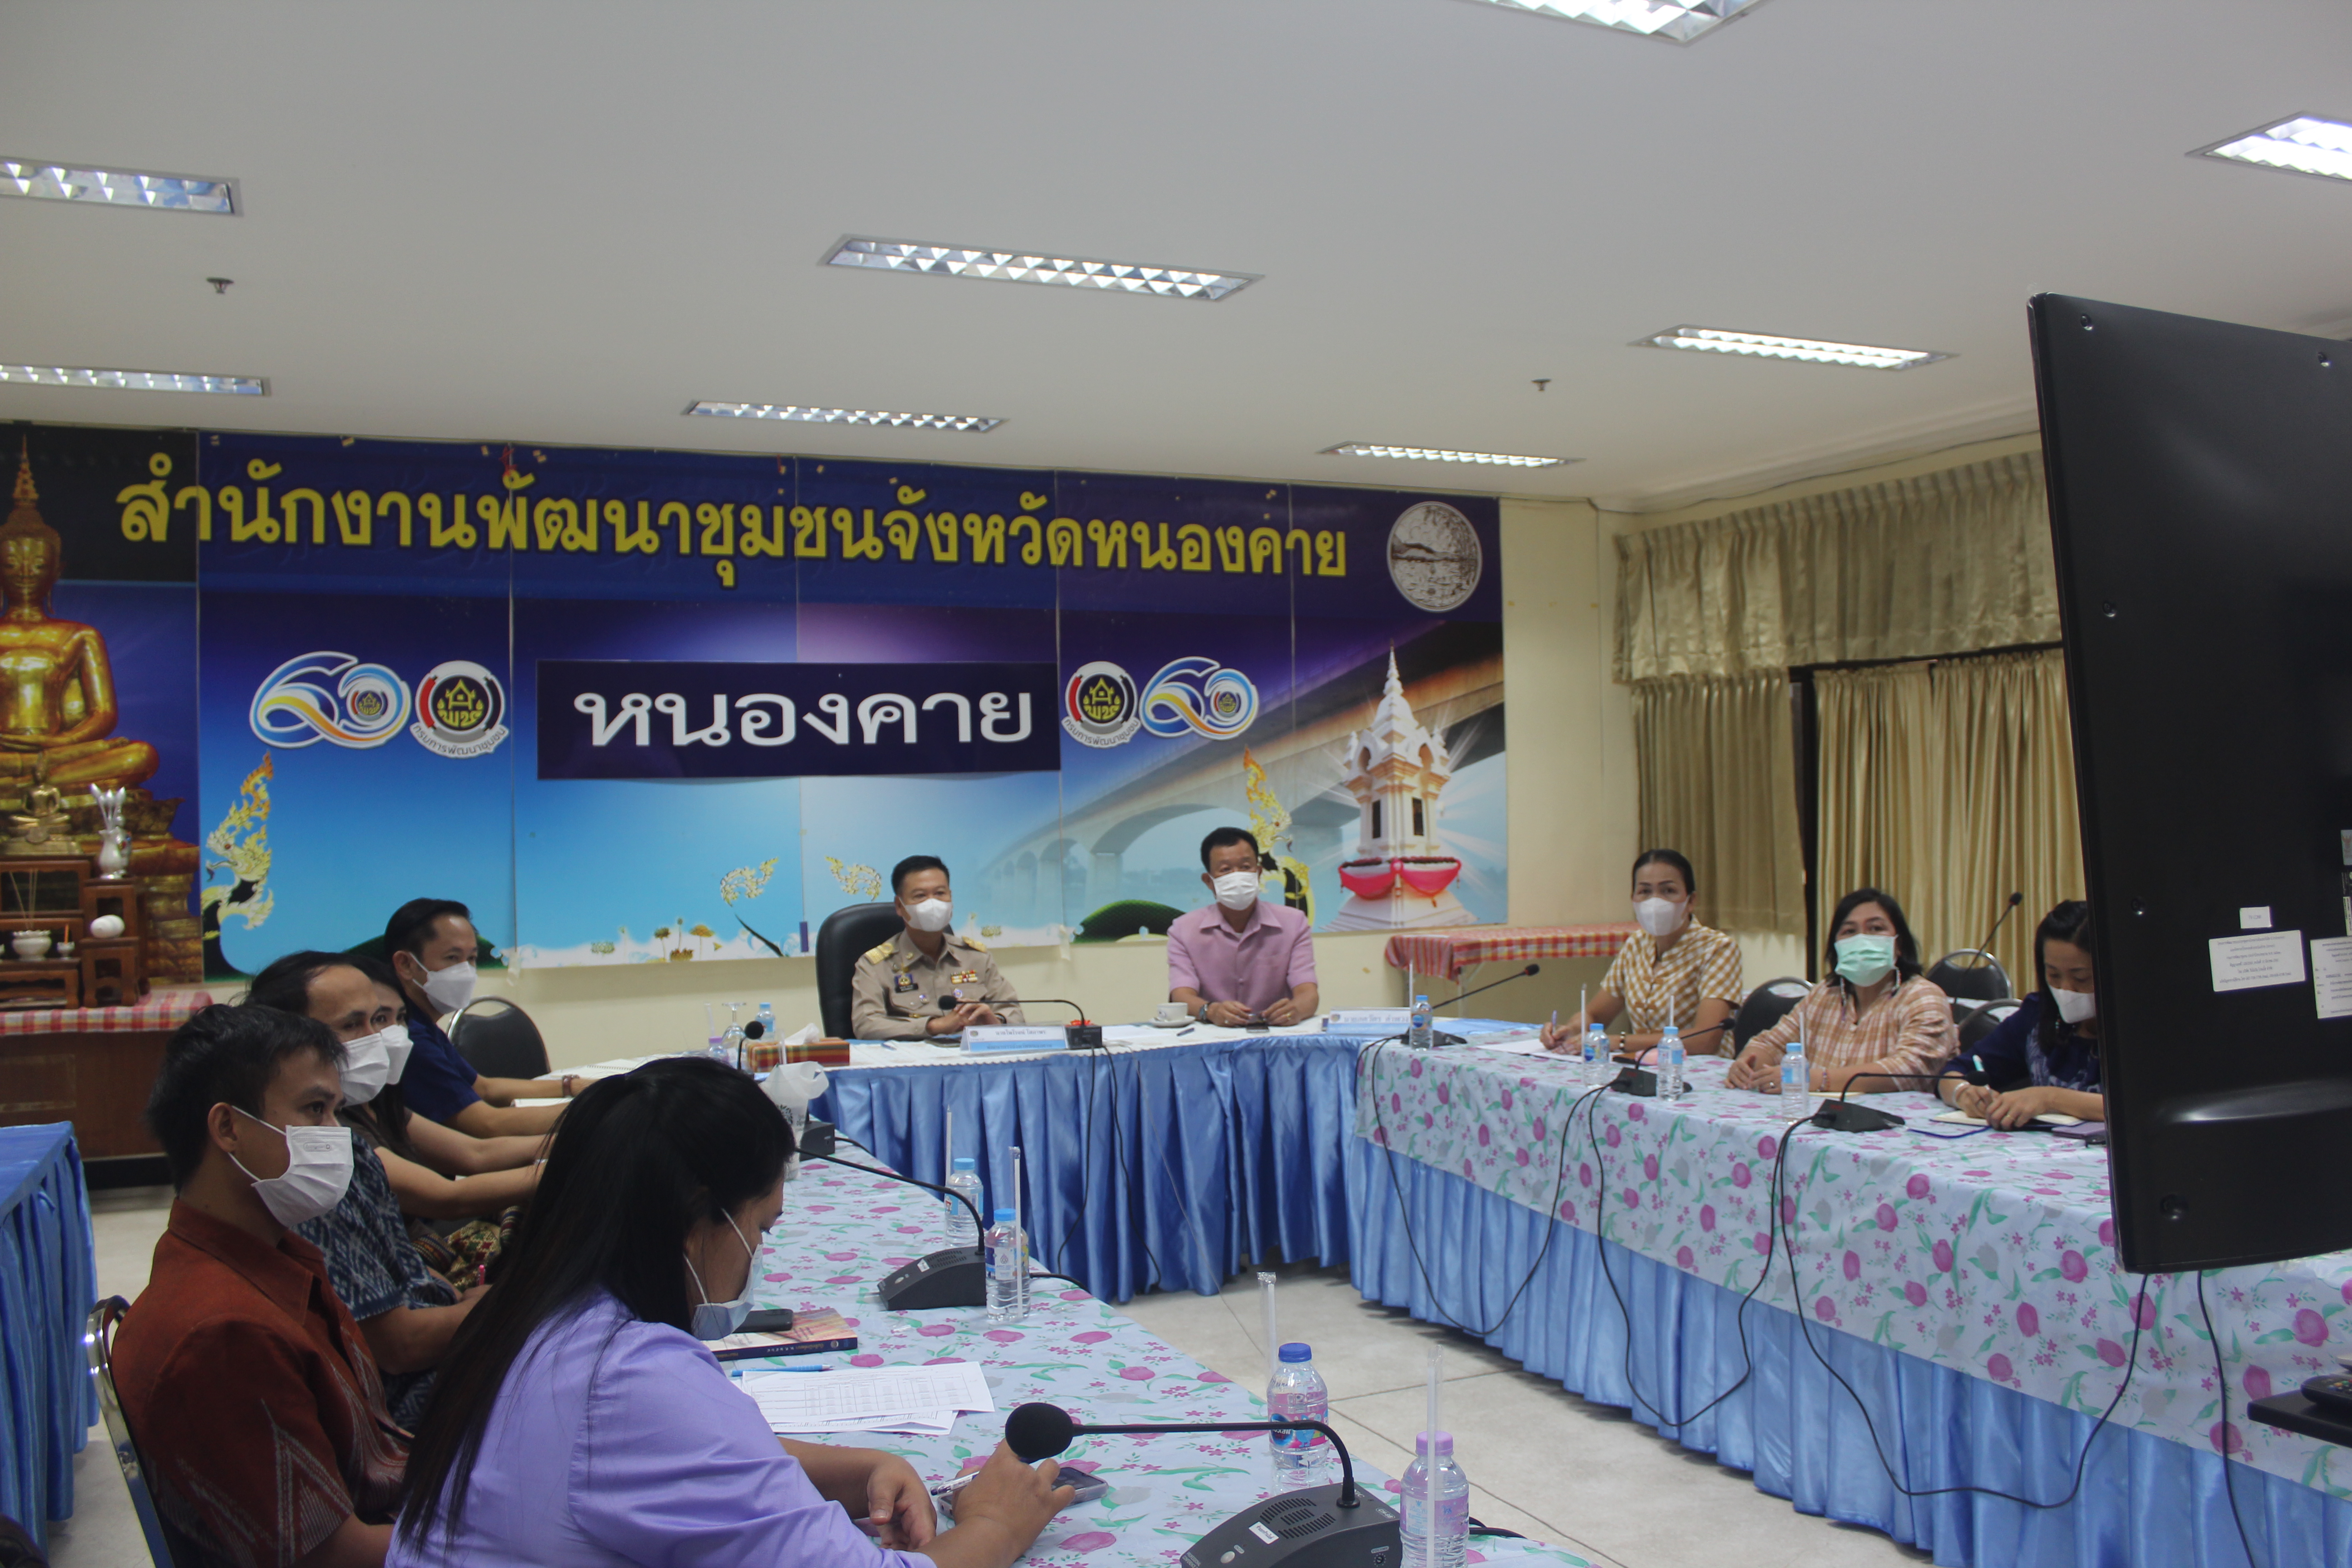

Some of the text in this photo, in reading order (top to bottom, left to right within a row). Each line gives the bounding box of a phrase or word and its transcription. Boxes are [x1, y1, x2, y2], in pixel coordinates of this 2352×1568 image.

[115, 453, 1347, 588] สำนักงานพัฒนาชุมชนจังหวัดหนองคาย
[412, 725, 506, 755] กรมการพัฒนาชุมชน
[573, 691, 1033, 747] หนองคาย
[1063, 718, 1139, 745] กรมการพัฒนาชุมชน
